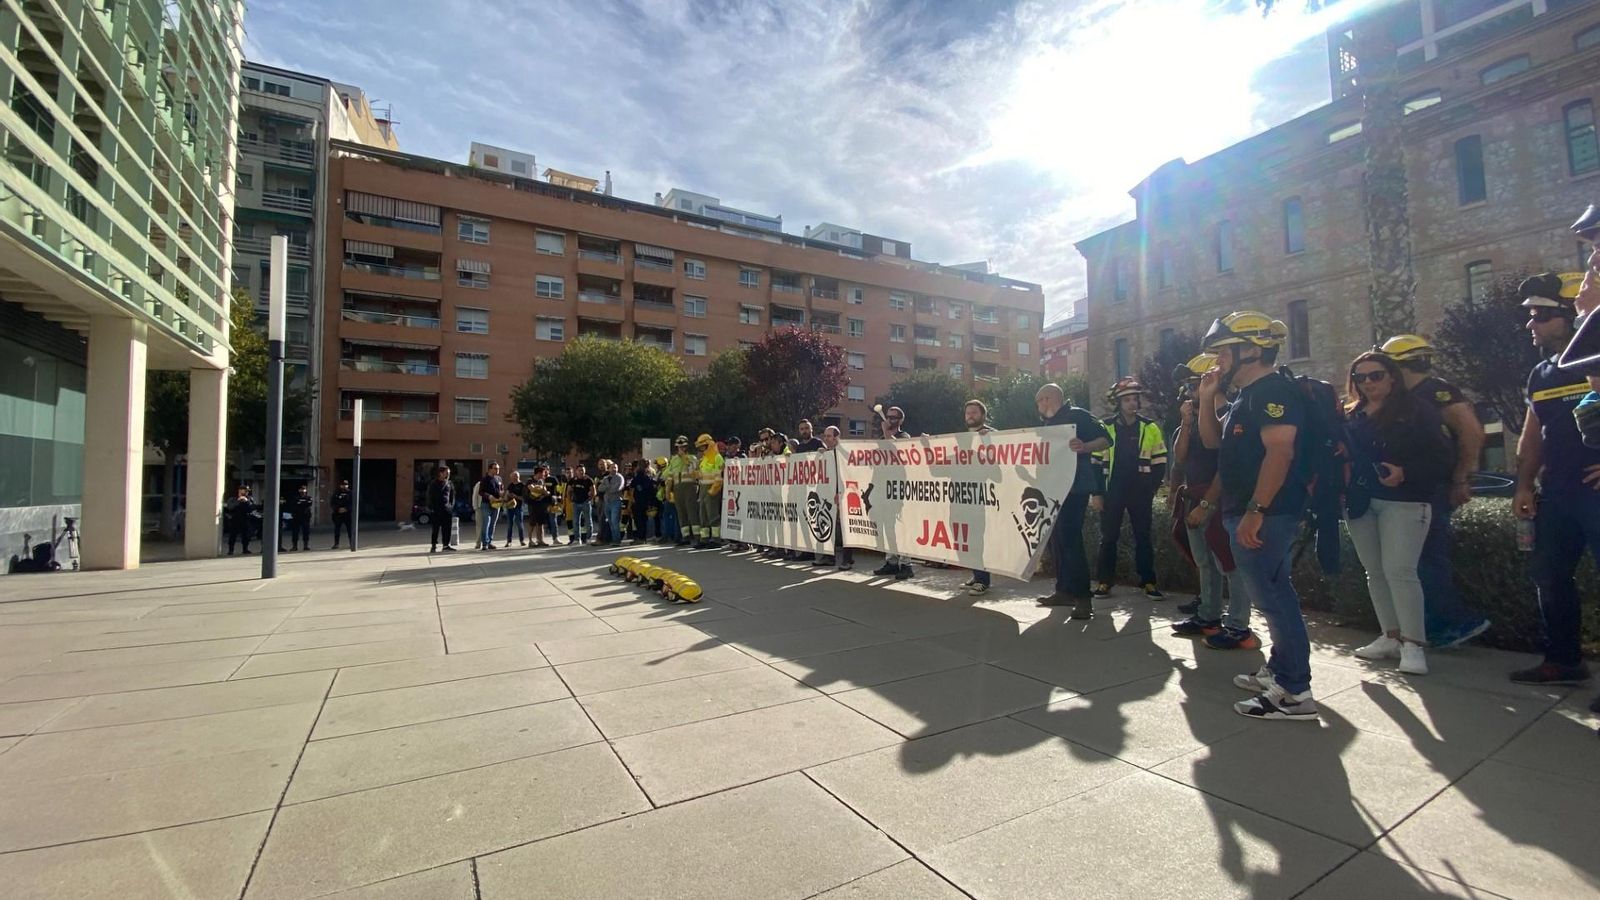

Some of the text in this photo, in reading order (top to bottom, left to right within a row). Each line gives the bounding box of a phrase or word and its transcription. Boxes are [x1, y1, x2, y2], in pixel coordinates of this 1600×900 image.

[847, 442, 1050, 466] APROVACIÓ DEL 1er CONVENI
[727, 465, 740, 485] PER
[787, 460, 830, 485] LABORAL
[886, 480, 1000, 511] DE BOMBERS FORESTALS,
[916, 519, 969, 552] JA!!
